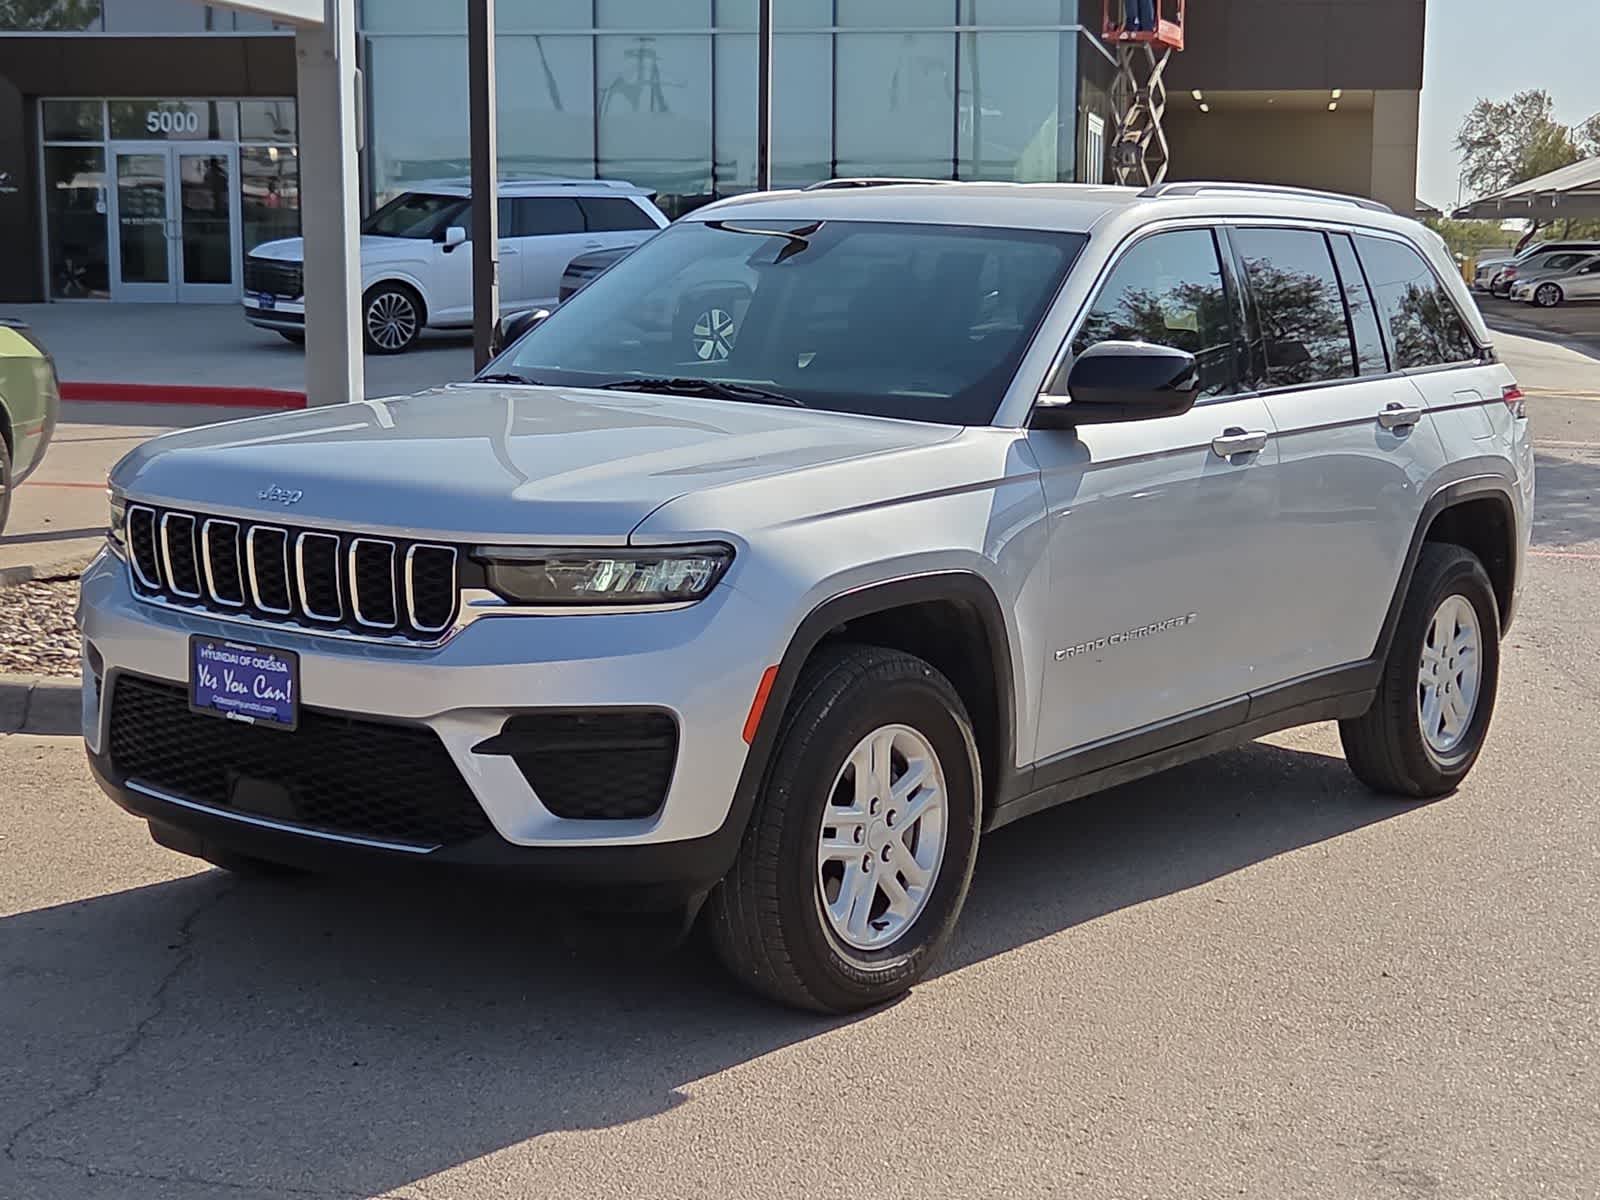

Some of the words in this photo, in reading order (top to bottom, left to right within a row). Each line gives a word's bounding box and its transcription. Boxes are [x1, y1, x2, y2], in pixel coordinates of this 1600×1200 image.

[146, 111, 198, 132] 5000
[258, 485, 303, 505] Jeep
[1054, 639, 1106, 661] GRAND
[1108, 612, 1197, 645] CHEROKEE
[201, 648, 238, 664] HYUNDAI
[239, 656, 252, 667] OF
[252, 658, 288, 672] ODESSA
[198, 664, 218, 690] Yes
[224, 669, 248, 692] You
[253, 674, 292, 703] Can!
